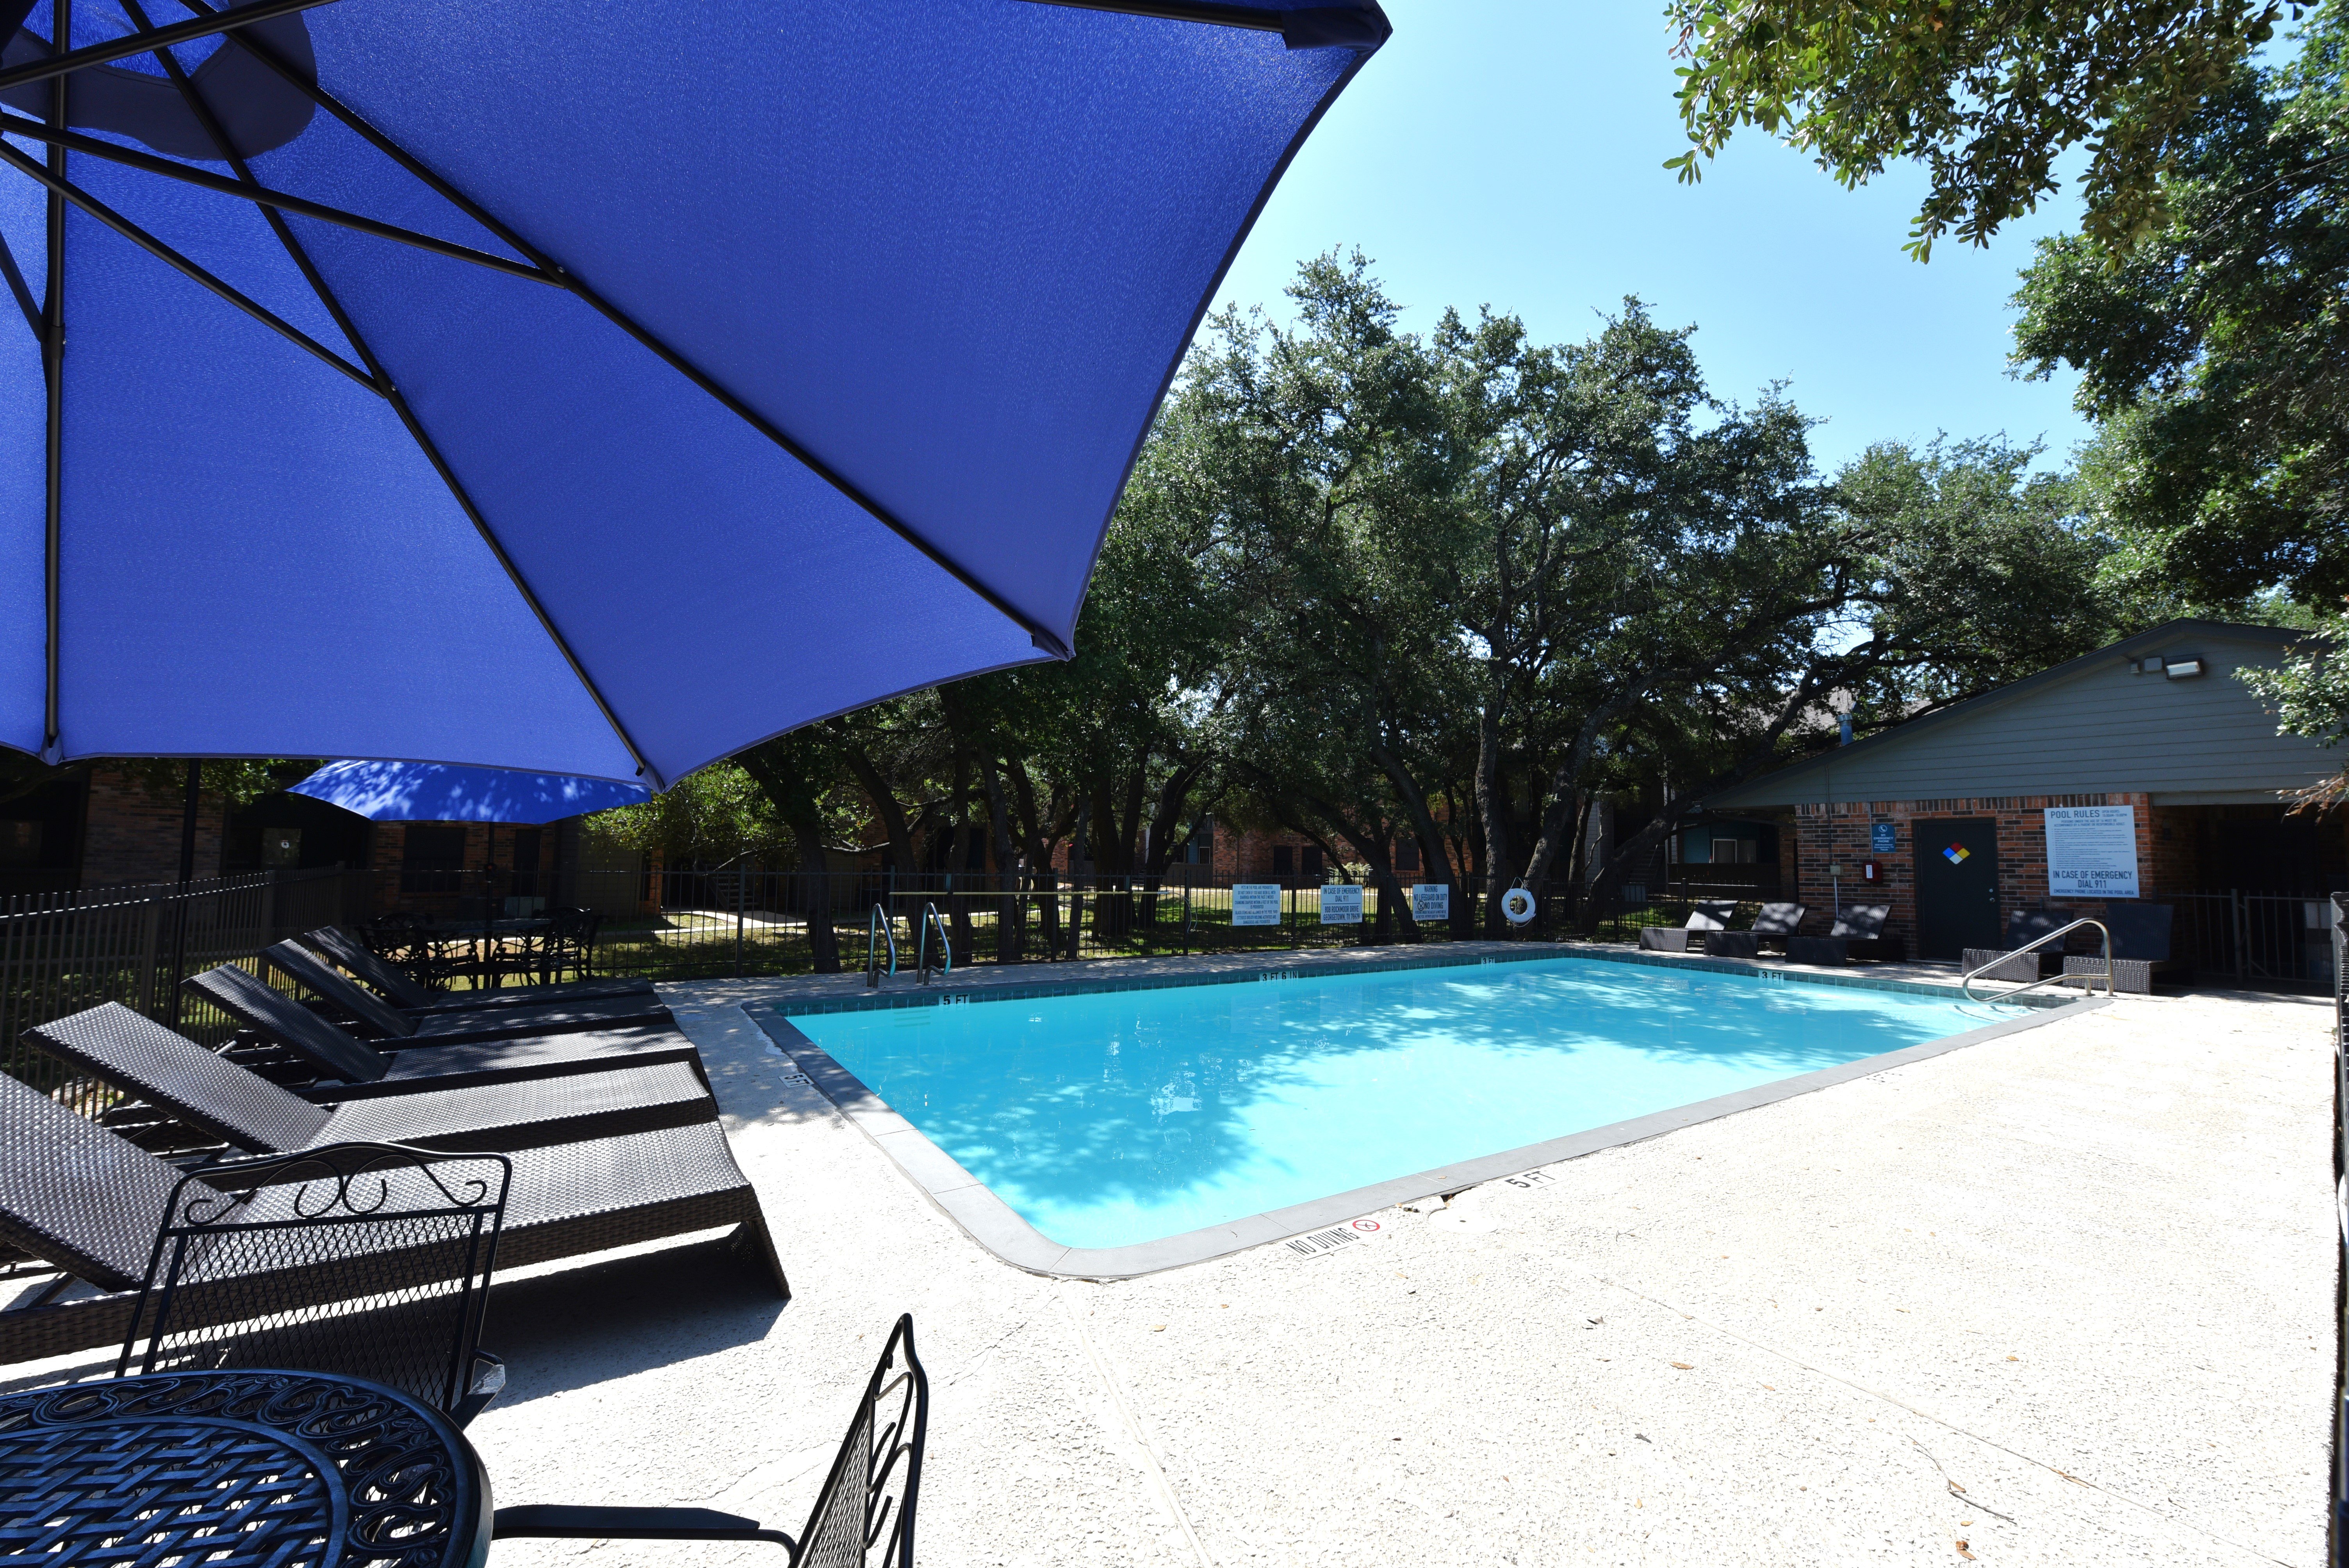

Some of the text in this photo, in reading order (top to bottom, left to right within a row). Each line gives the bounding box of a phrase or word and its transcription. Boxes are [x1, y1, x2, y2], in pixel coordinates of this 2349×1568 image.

[2091, 871, 2132, 879] EMERGENCY
[2078, 880, 2093, 888] DIAL
[1290, 971, 1297, 979] IN
[943, 994, 968, 1005] 5 FT
[1504, 1171, 1556, 1188] 5 FT
[1285, 1240, 1317, 1256] NO
[1306, 1228, 1361, 1249] DIVING
